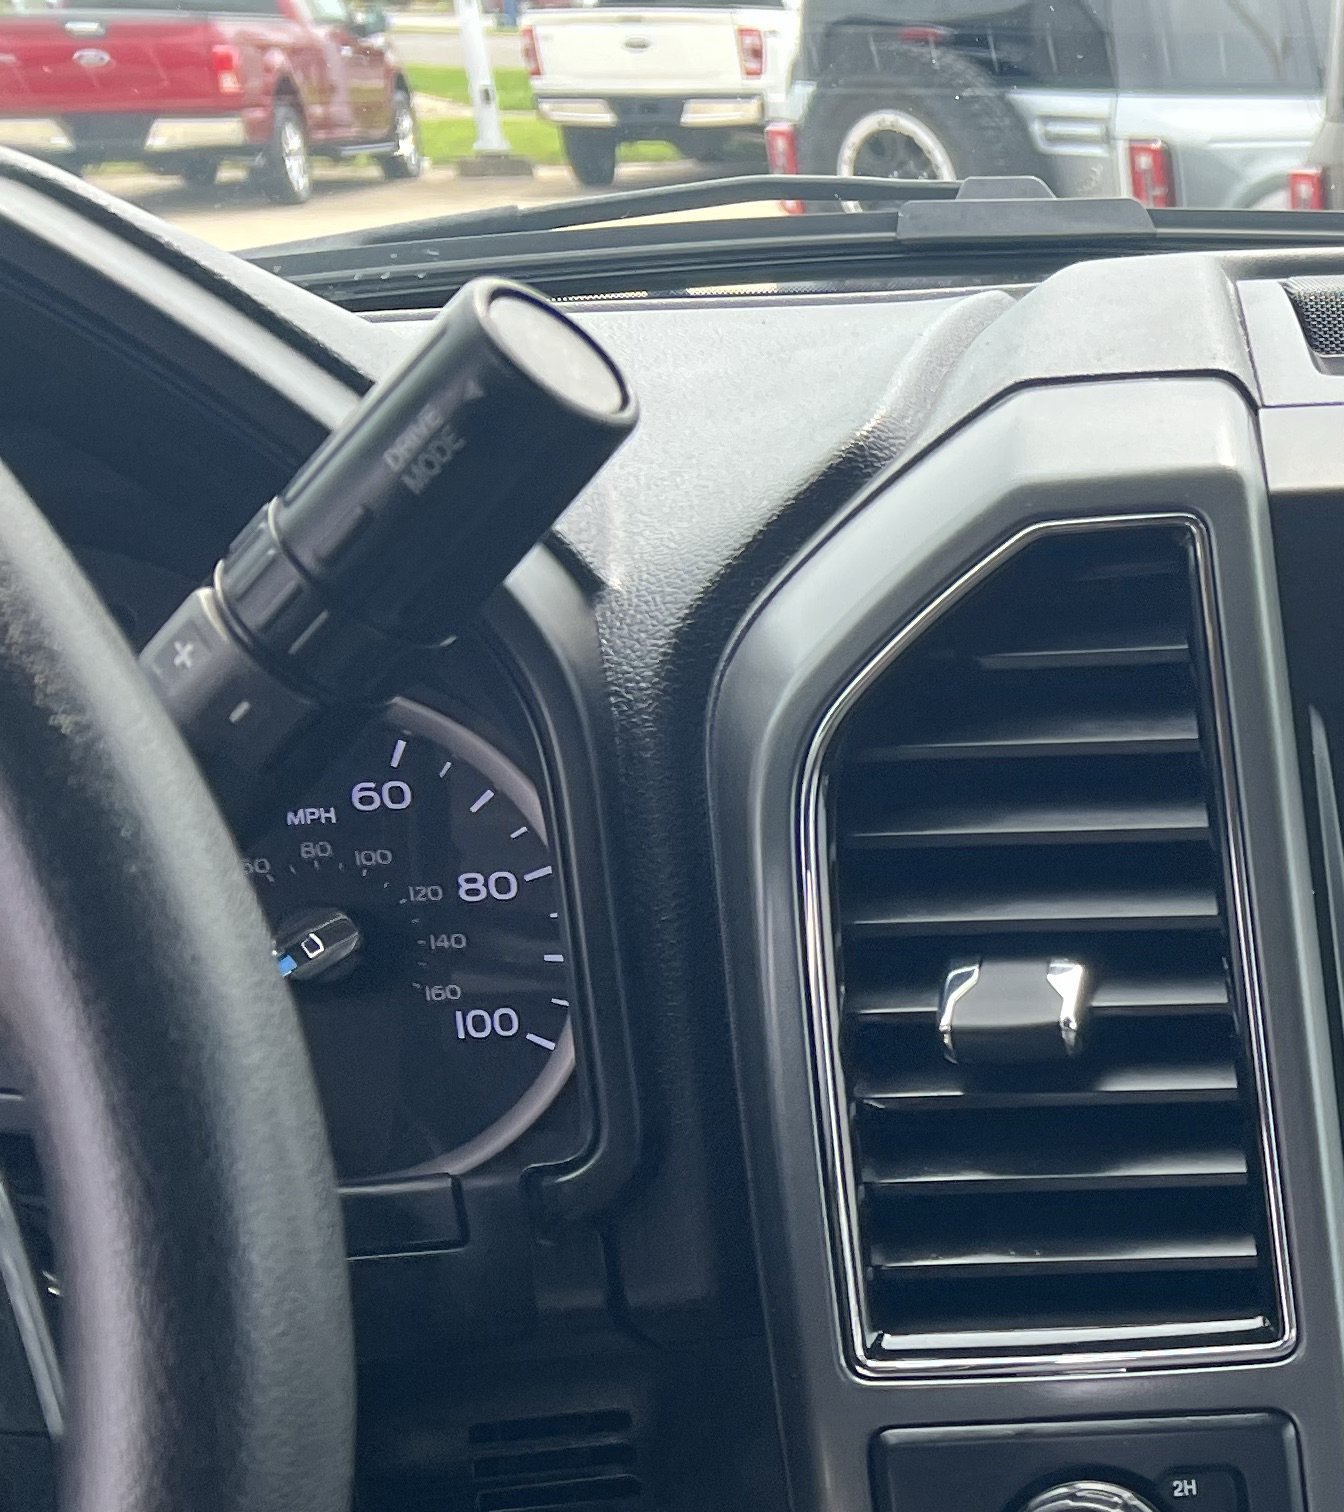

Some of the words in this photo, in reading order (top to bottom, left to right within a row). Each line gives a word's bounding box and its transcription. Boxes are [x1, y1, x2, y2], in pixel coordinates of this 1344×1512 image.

[401, 423, 467, 495] MODE
[350, 780, 412, 812] 60
[286, 806, 337, 826] MPH
[300, 841, 333, 859] 80
[354, 849, 393, 867] 100
[407, 884, 443, 902] 120
[456, 871, 518, 902] 80
[428, 932, 467, 951] 140
[424, 984, 462, 1002] 160
[454, 1006, 520, 1040] 100
[1172, 1479, 1198, 1498] 2H
